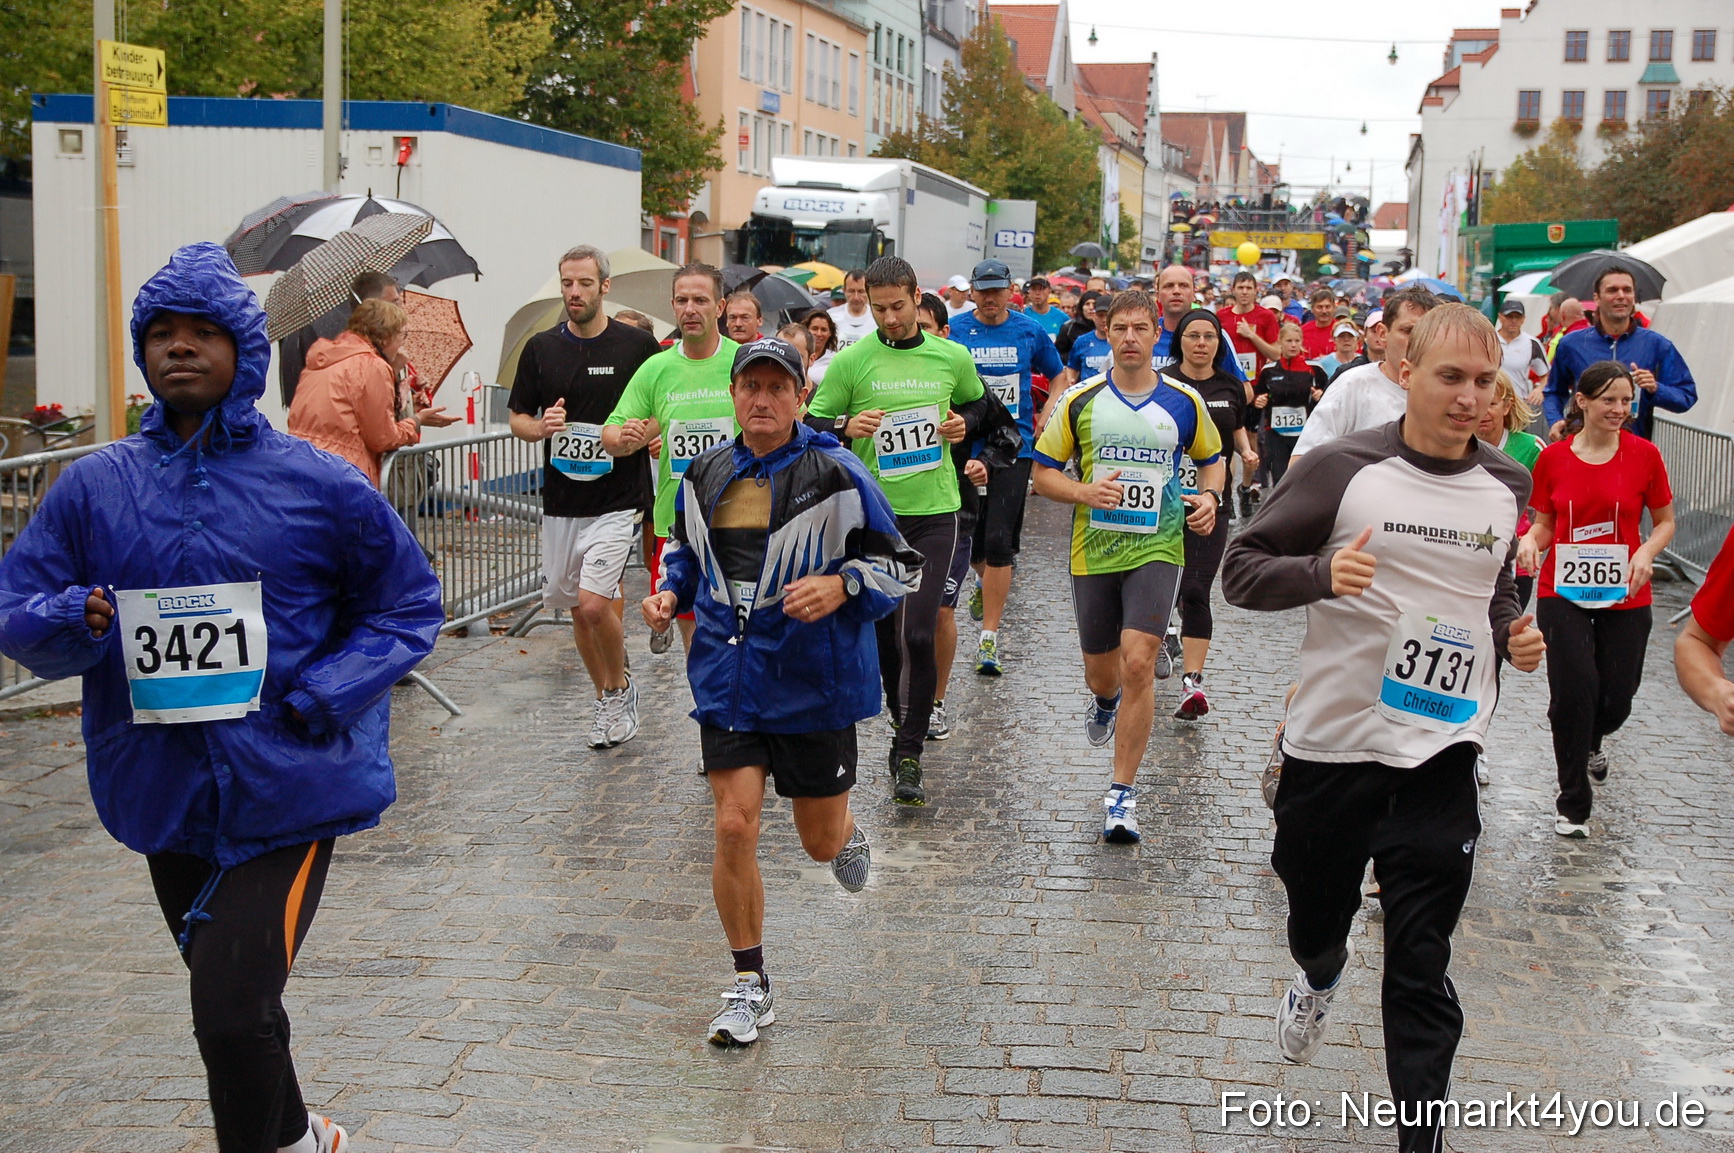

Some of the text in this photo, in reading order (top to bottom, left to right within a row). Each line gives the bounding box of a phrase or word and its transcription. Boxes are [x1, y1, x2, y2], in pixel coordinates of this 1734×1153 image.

[113, 46, 148, 65] Kinder-
[784, 199, 845, 213] BOCK
[995, 229, 1035, 248] BO
[1247, 235, 1286, 246] START
[970, 346, 1018, 358] HUBER
[587, 366, 615, 375] THULE
[992, 387, 1015, 403] 74
[892, 412, 920, 423] BOCK
[1275, 414, 1303, 426] 3125
[880, 423, 937, 453] 3112
[1100, 433, 1147, 445] TEAM
[558, 436, 607, 459] 2332
[1100, 446, 1168, 464] BOCK
[893, 453, 932, 466] Matthias
[1103, 509, 1146, 526] Wolfgang
[1584, 526, 1603, 536] DEHN
[1563, 561, 1622, 585] 2365
[158, 594, 216, 610] BOCK
[1579, 590, 1603, 600] Julia
[1433, 623, 1471, 641] BOCK
[135, 618, 249, 674] 3421
[1395, 638, 1476, 695] 3131
